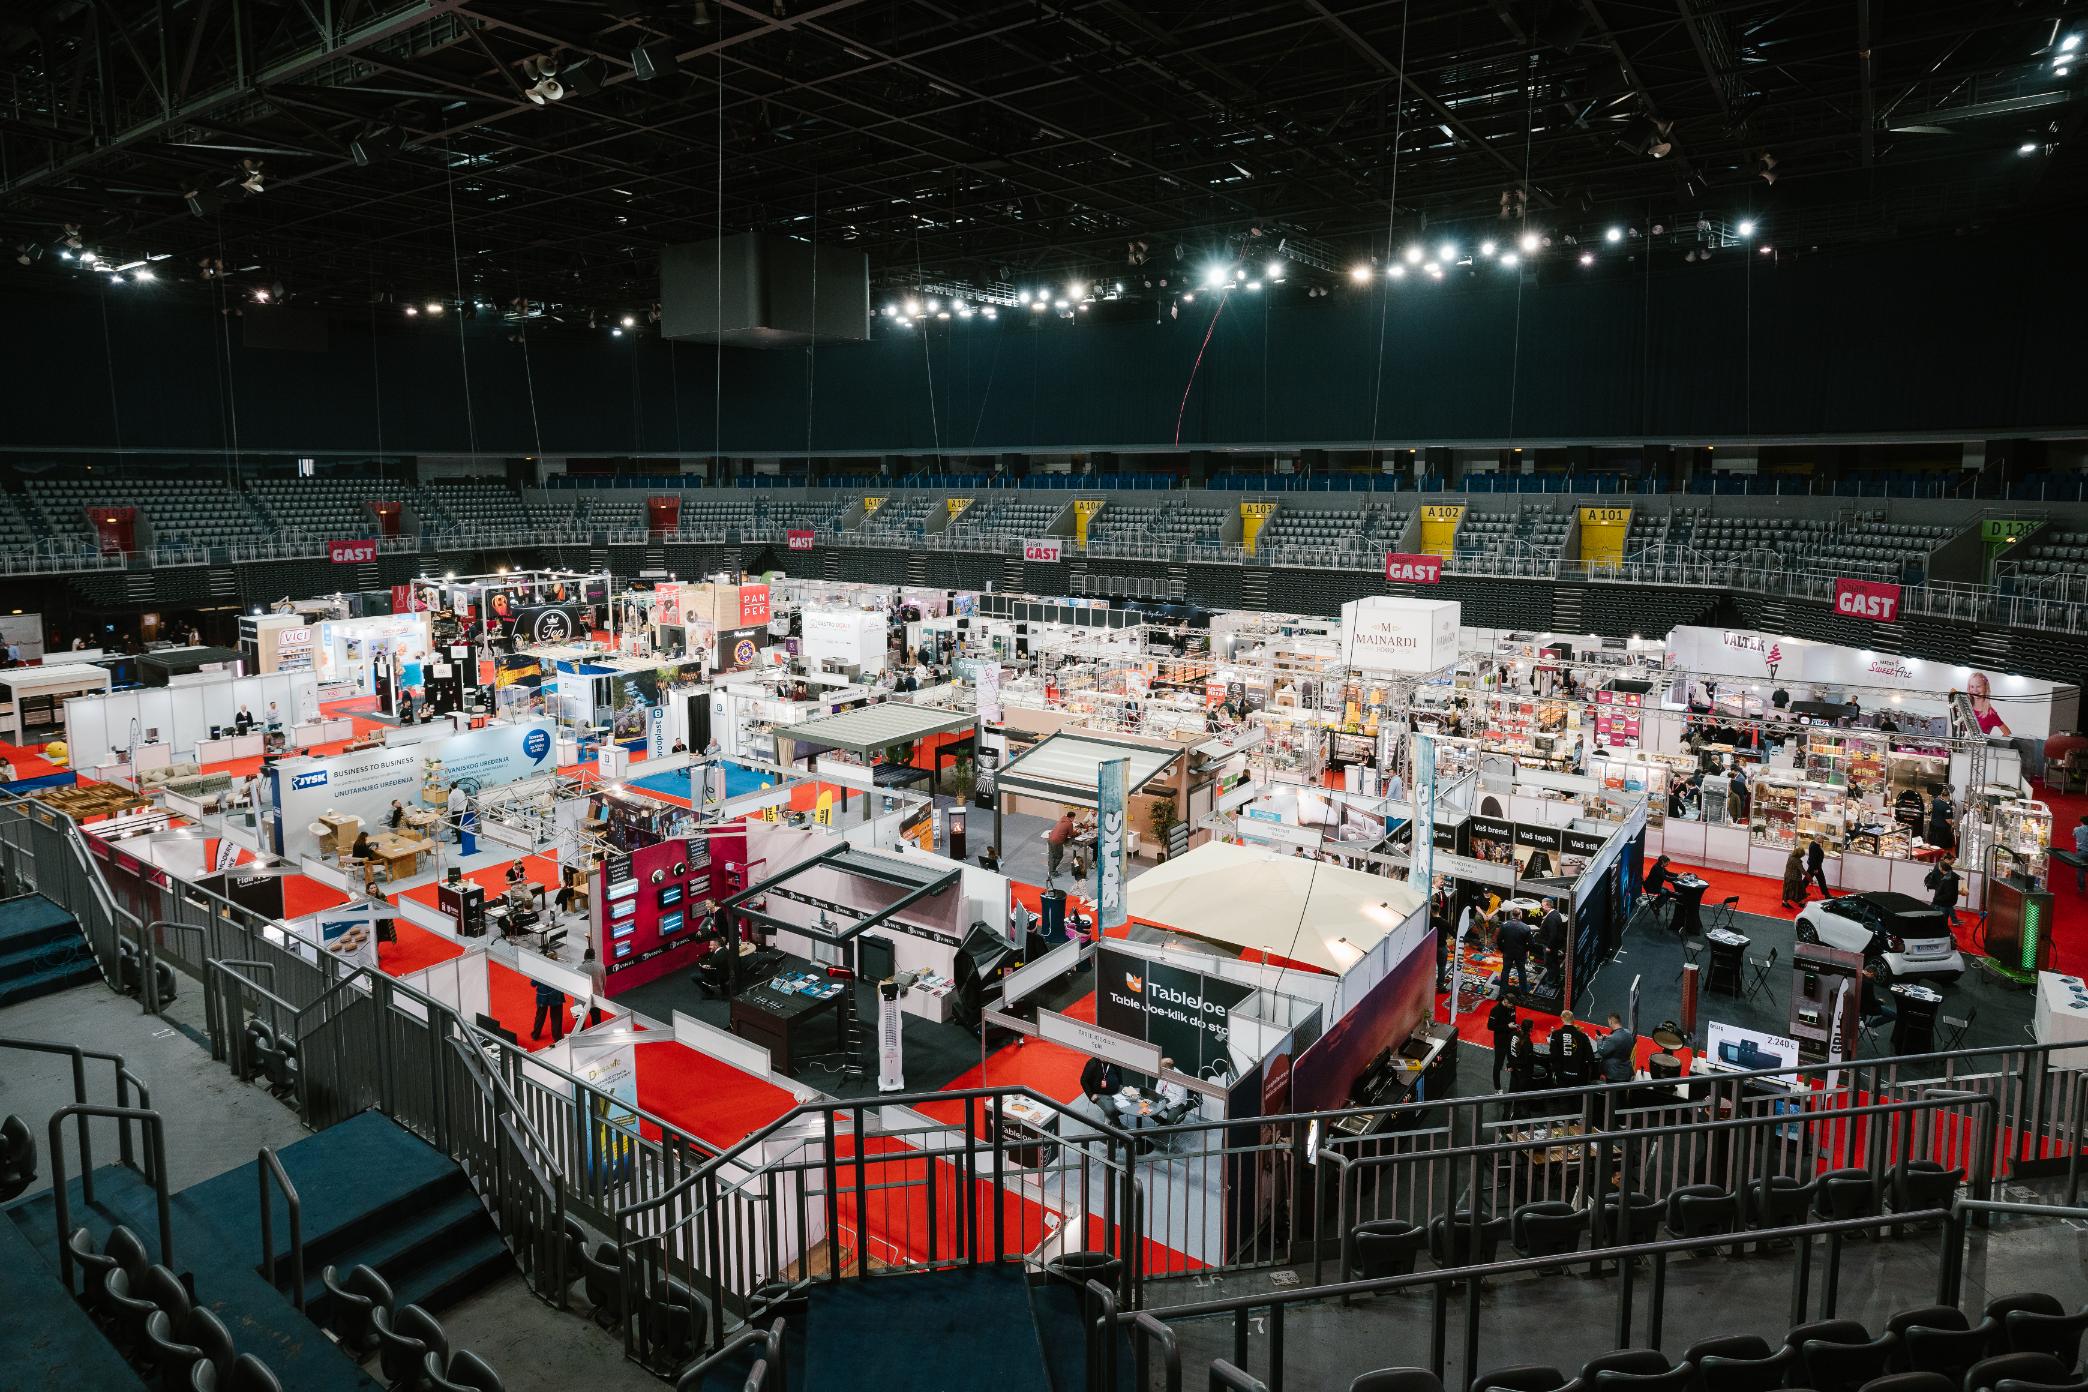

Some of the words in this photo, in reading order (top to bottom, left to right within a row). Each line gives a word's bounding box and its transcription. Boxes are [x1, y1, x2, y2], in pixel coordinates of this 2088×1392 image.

[1080, 502, 1084, 510] A
[1246, 505, 1252, 514] A
[1428, 507, 1435, 517] A
[1438, 507, 1458, 518] 102
[1588, 510, 1596, 520] A
[1601, 510, 1623, 520] 101
[1992, 521, 1999, 536] D
[789, 537, 813, 548] GAST
[332, 547, 374, 562] GAST
[1026, 547, 1059, 561] GAST
[1389, 563, 1438, 582] GAST
[744, 593, 765, 603] PAN
[744, 606, 765, 616] PEK
[1839, 592, 1894, 618] GAST
[542, 623, 565, 639] Tea
[1381, 623, 1391, 633] M
[285, 632, 307, 642] VICI
[1356, 633, 1417, 648] MAINARDI
[1723, 632, 1765, 652] VALTEK
[334, 765, 369, 778] BUSINESS
[370, 763, 380, 771] TO
[380, 757, 414, 769] BUSINESS
[299, 773, 327, 786] JYSK
[334, 783, 379, 798] UNUTARNJEG
[1474, 824, 1487, 832] Vaš
[1520, 831, 1533, 840] Vaš
[1571, 840, 1585, 849] Vaš
[1148, 982, 1226, 1017] TableJoe
[1110, 991, 1141, 1010] Table
[1141, 1003, 1188, 1024] Joe-klik
[1189, 1017, 1207, 1029] do
[1767, 1036, 1790, 1048] 2.240
